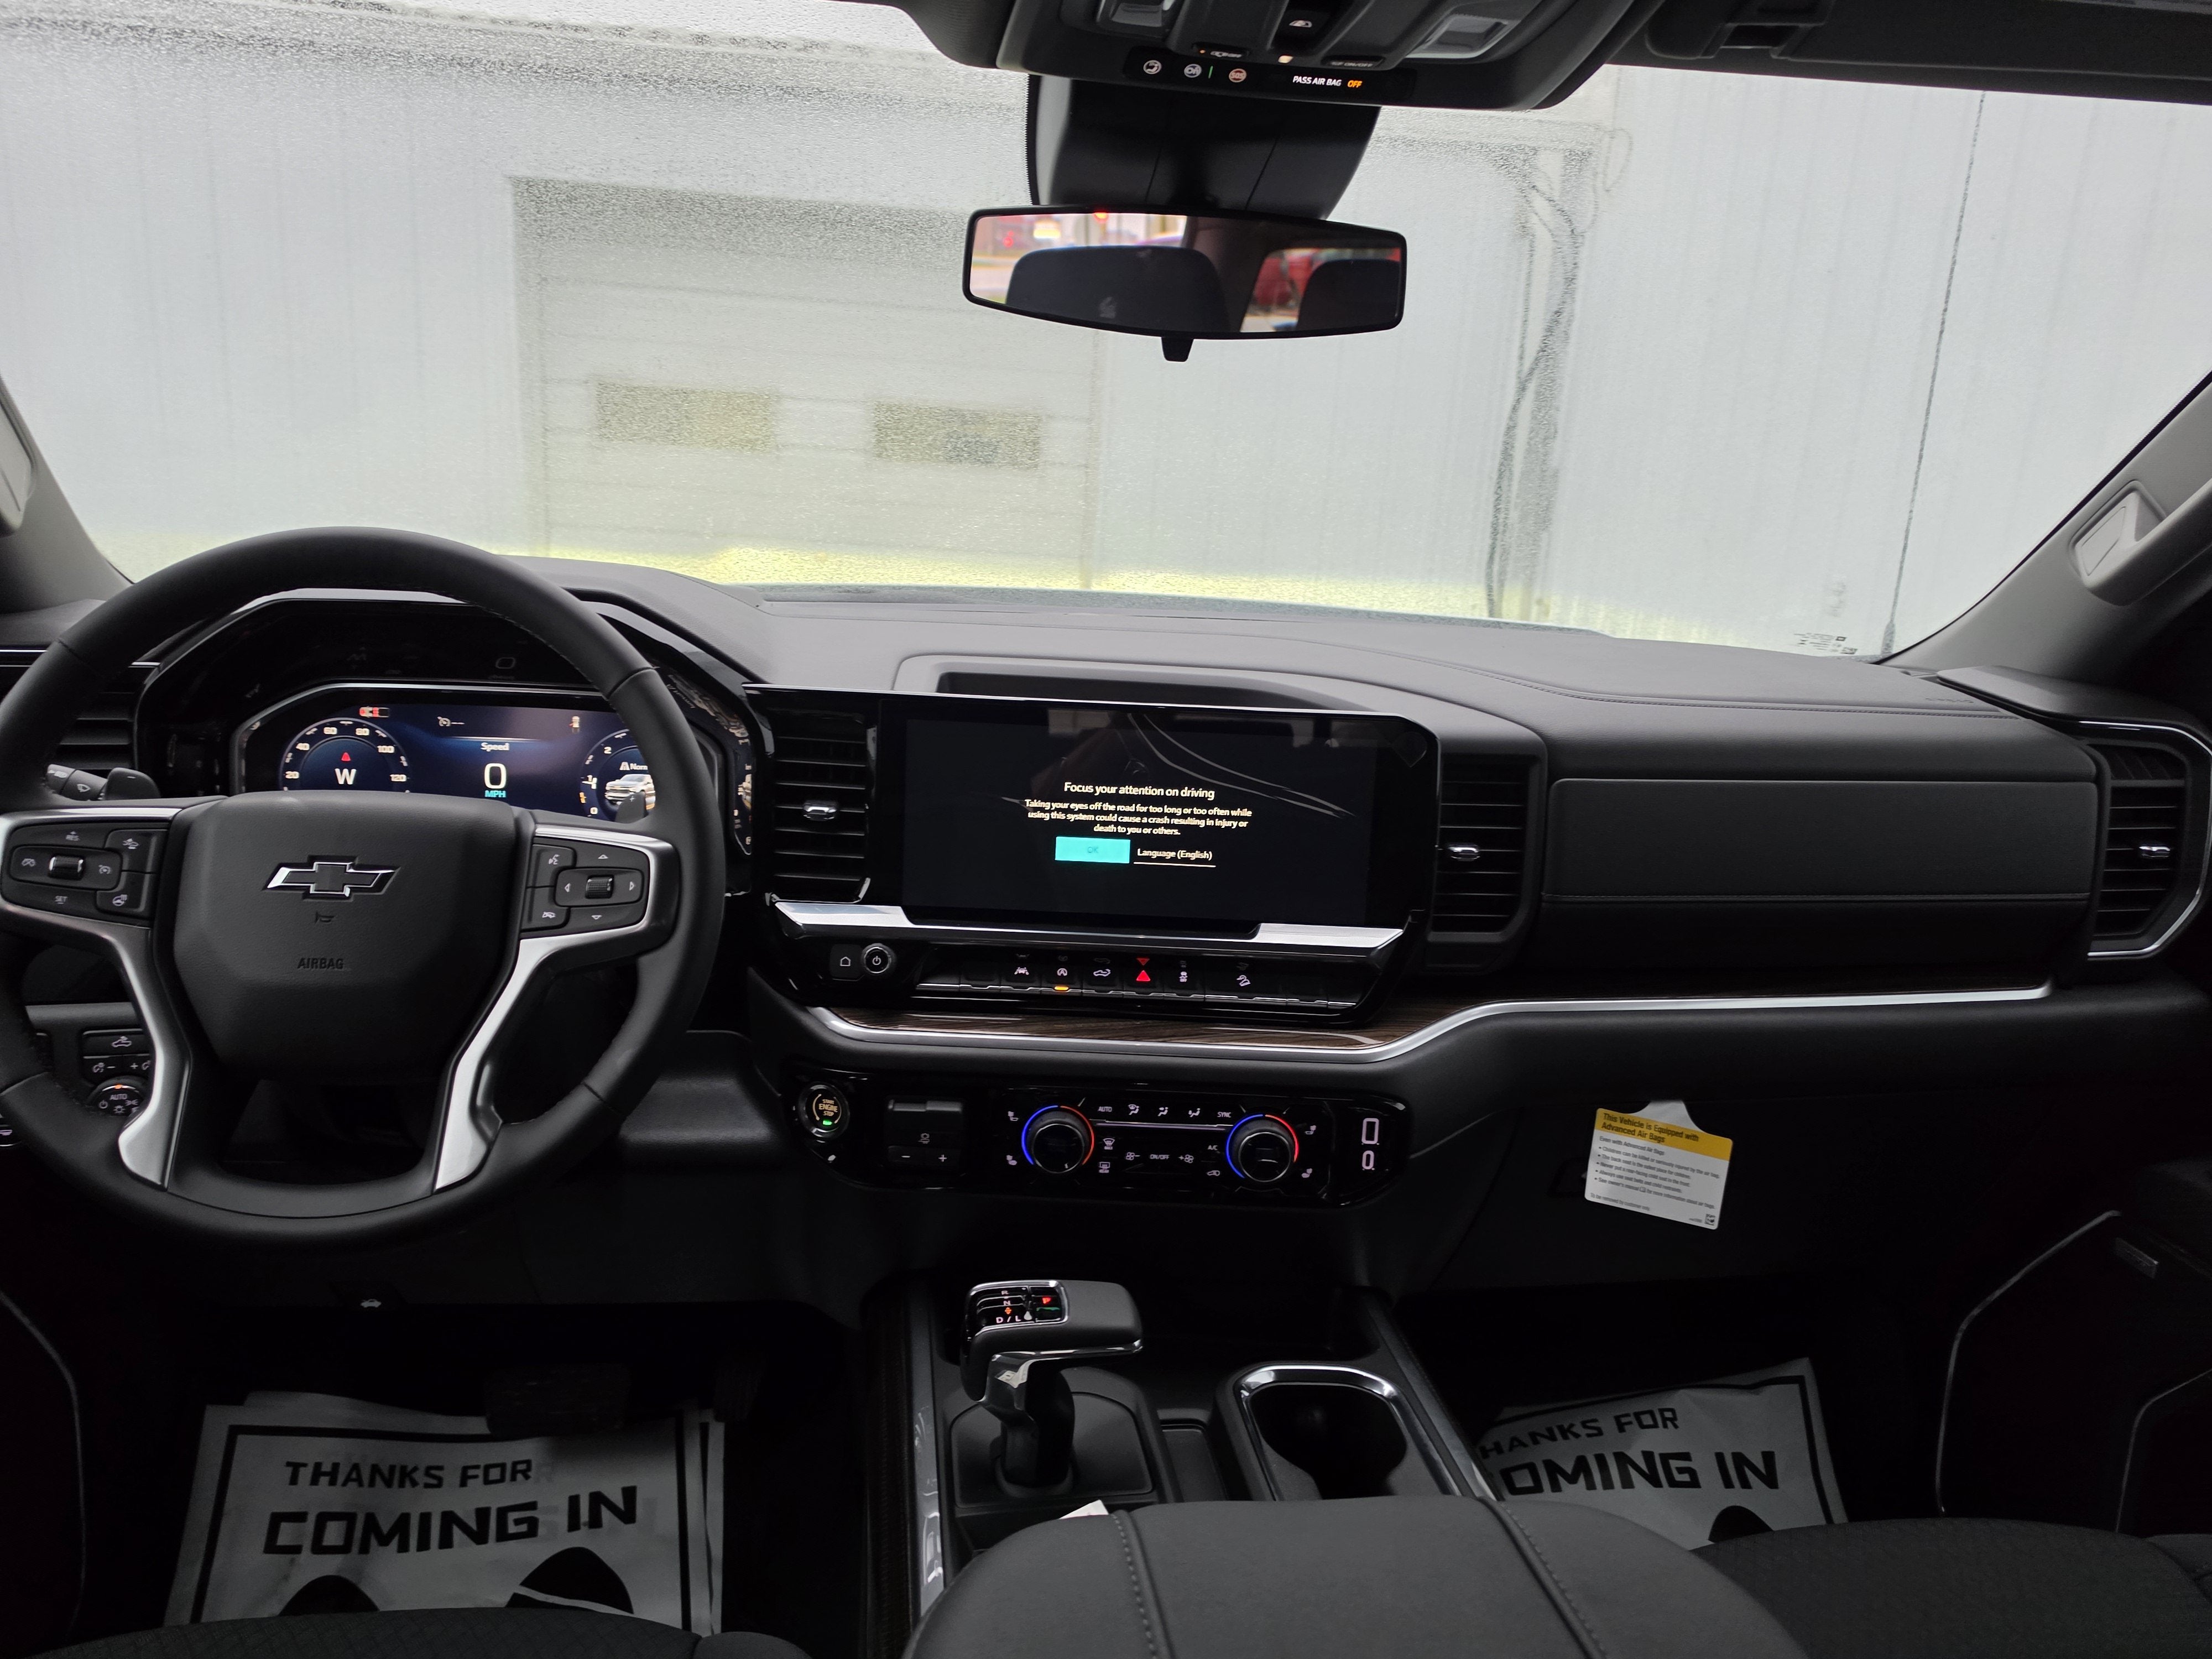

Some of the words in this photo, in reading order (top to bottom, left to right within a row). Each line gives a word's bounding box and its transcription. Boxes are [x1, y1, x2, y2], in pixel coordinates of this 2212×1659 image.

[1292, 76, 1312, 84] PASS
[480, 742, 509, 752] Speed
[335, 768, 357, 785] W
[389, 774, 407, 782] 120
[484, 763, 507, 790] 0
[1064, 782, 1094, 792] Focus
[1094, 786, 1118, 796] your
[1118, 785, 1164, 796] attention
[1181, 787, 1215, 800] driving
[1025, 799, 1051, 810] Taking
[1164, 805, 1182, 816] long
[1208, 807, 1229, 816] often
[1231, 808, 1252, 817] while
[1027, 811, 1050, 821] using
[1051, 811, 1066, 820] this
[1066, 813, 1094, 822] system
[1095, 813, 1117, 822] could
[1171, 817, 1205, 827] resulting
[1215, 818, 1238, 829] injury
[1093, 824, 1117, 832] death
[1126, 827, 1141, 835] you
[1152, 827, 1181, 835] others.
[1137, 848, 1176, 859] Language
[1177, 850, 1213, 860] (English)
[297, 958, 343, 969] AIRBAG
[818, 1104, 838, 1113] ENGINE
[1602, 1122, 1636, 1136] Advanced
[1649, 1133, 1665, 1144] Bags
[1603, 1113, 1618, 1122] This
[1619, 1117, 1644, 1129] Vehicle
[1653, 1125, 1683, 1139] Equipped
[1685, 1132, 1699, 1141] with
[1480, 1418, 1604, 1459] HANKS
[1614, 1407, 1679, 1433] FOR
[284, 1460, 444, 1489] THANKS
[459, 1459, 533, 1488] FOR
[1499, 1449, 1702, 1496] OMING
[1715, 1450, 1779, 1489] IN
[263, 1500, 539, 1555] COMING
[567, 1484, 638, 1533] IN
